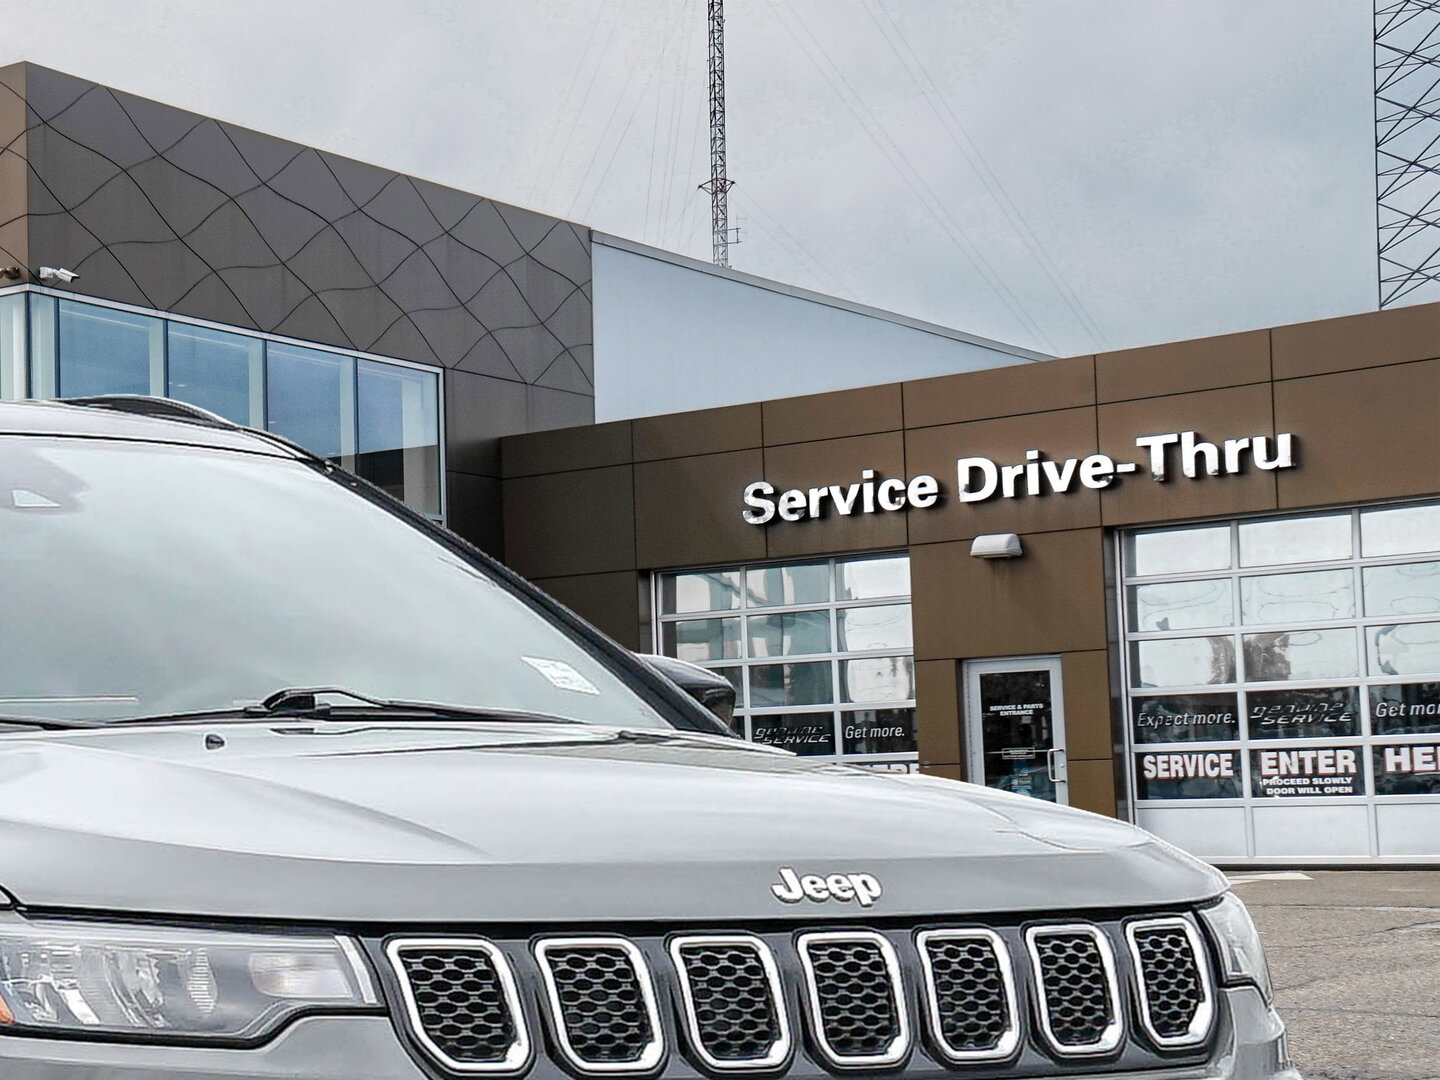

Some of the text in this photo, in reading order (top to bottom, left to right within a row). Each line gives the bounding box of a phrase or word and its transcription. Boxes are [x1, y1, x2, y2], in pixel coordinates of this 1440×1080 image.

[742, 430, 1296, 525] Service Drive-Thru
[1375, 702, 1440, 717] Get mo
[1137, 712, 1236, 728] Expect more.
[1261, 712, 1355, 725] SERVICE
[762, 733, 832, 745] SERVICE
[845, 725, 905, 739] Get more.
[1143, 753, 1234, 780] SERVICE
[1260, 749, 1357, 777] ENTER
[1384, 746, 1440, 773] HE
[1262, 776, 1352, 786] PROCEED SLOWLY
[1266, 785, 1353, 795] DOOR WILL OPEN
[770, 866, 883, 908] Jeep
